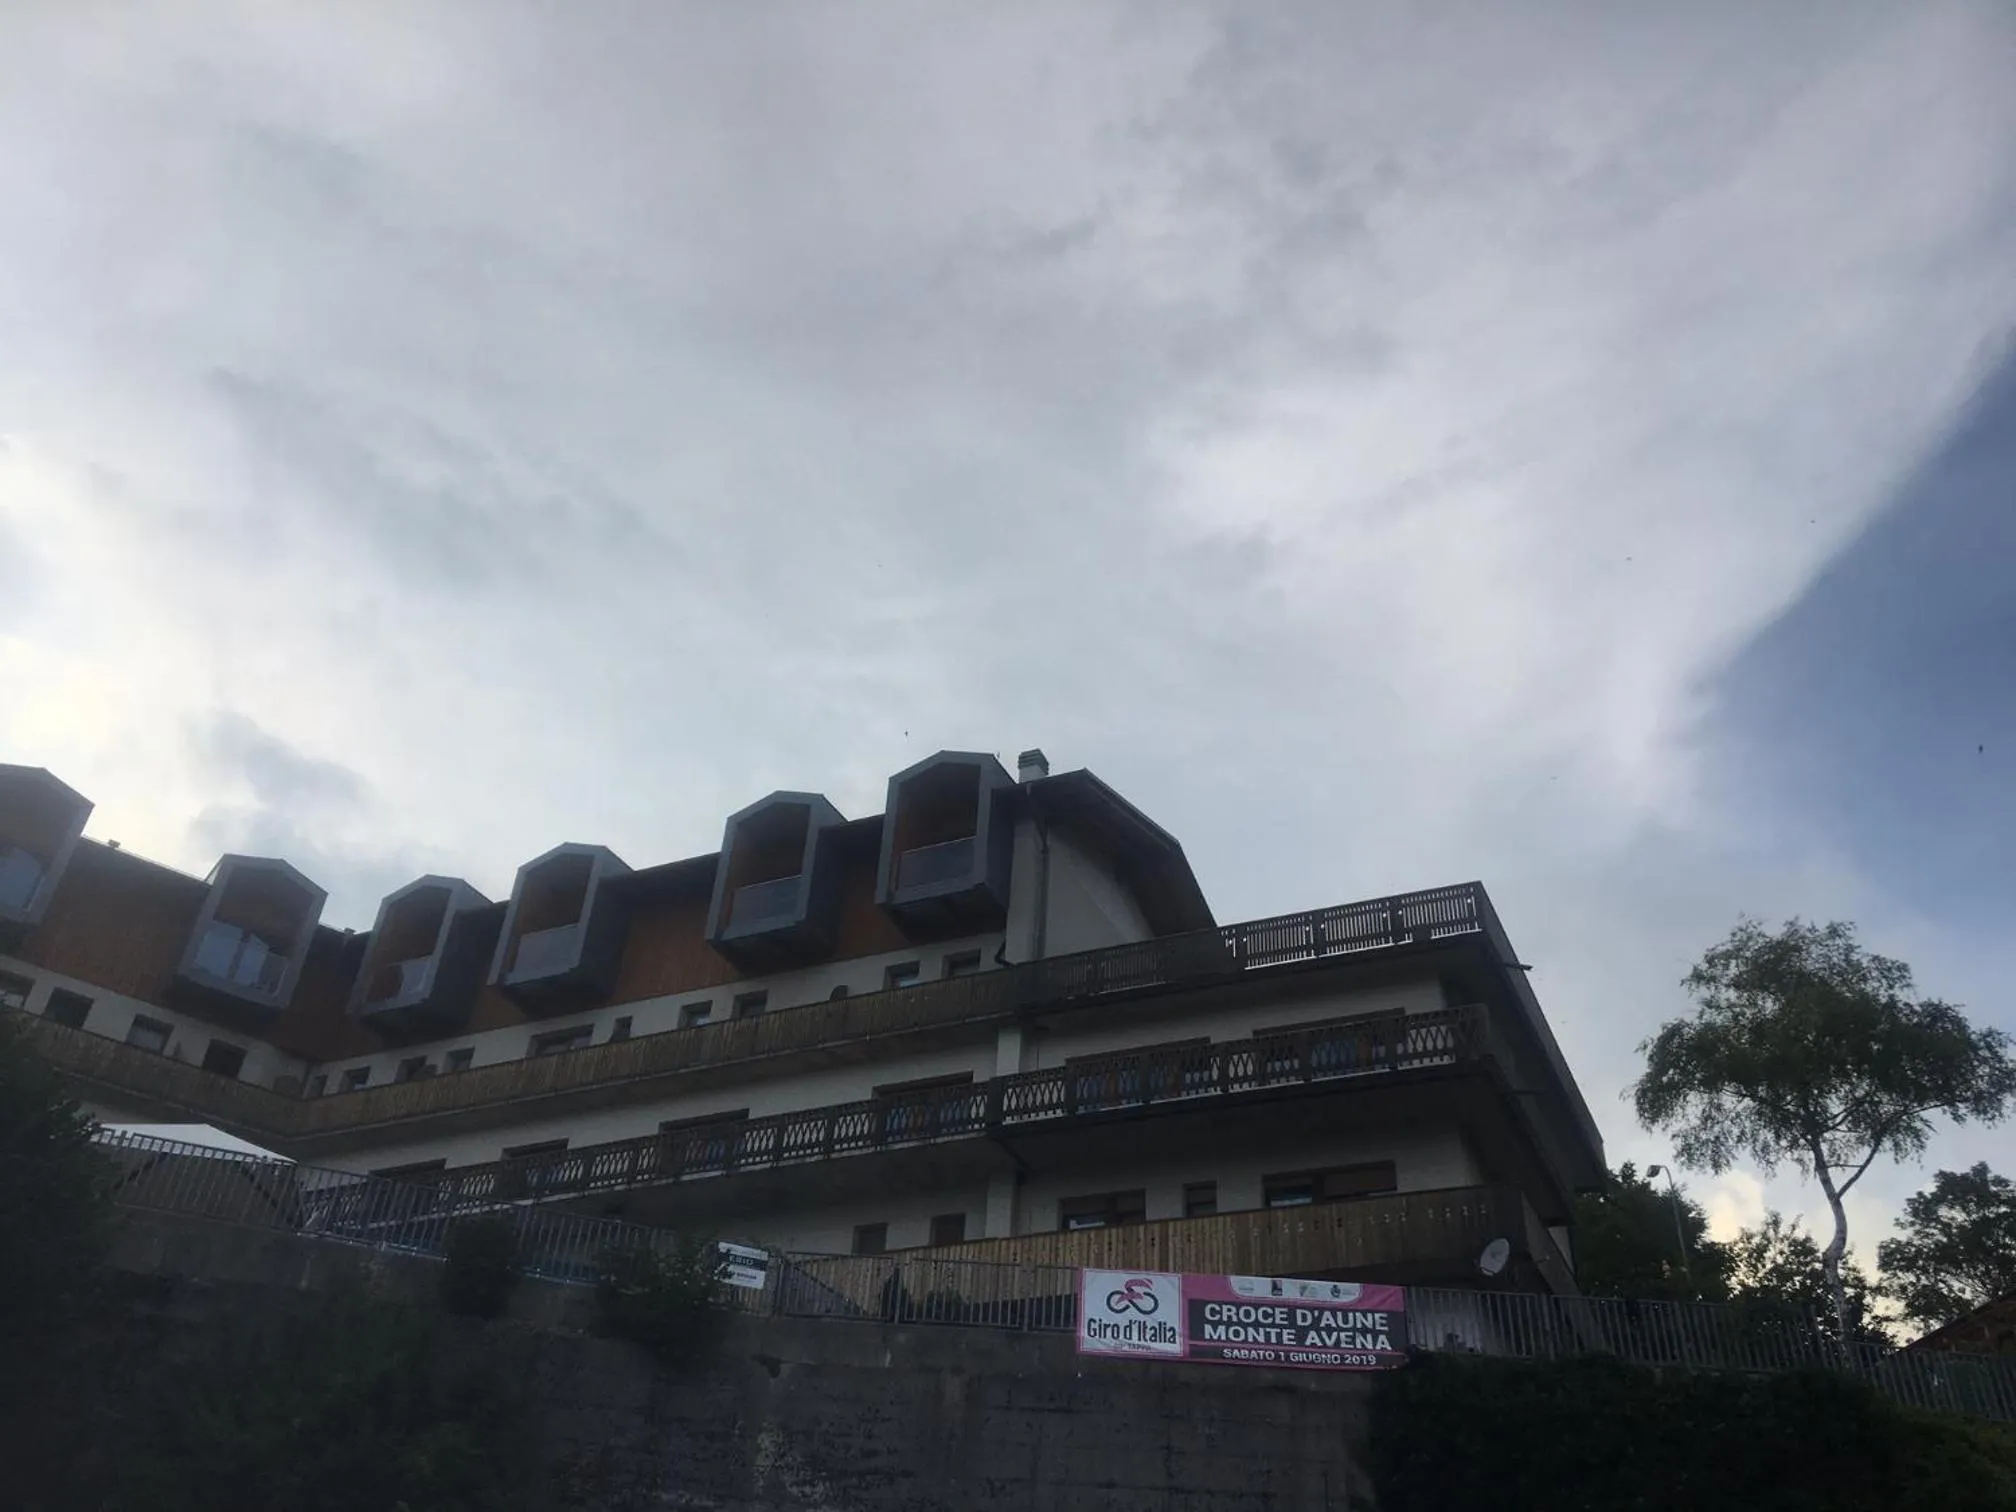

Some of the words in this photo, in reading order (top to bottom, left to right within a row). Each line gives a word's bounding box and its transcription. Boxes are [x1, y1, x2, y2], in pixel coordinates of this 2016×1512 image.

[1204, 1303, 1288, 1323] CROCE
[1296, 1309, 1389, 1330] D'AUNE
[1087, 1318, 1120, 1339] Giro
[1123, 1319, 1177, 1344] d'Italia
[1204, 1324, 1296, 1344] MONTE
[1305, 1329, 1392, 1350] AVENA
[1223, 1348, 1275, 1361] SABATO
[1279, 1351, 1286, 1362] 1
[1290, 1352, 1341, 1365] GIUGNO
[1344, 1354, 1377, 1366] 2019
